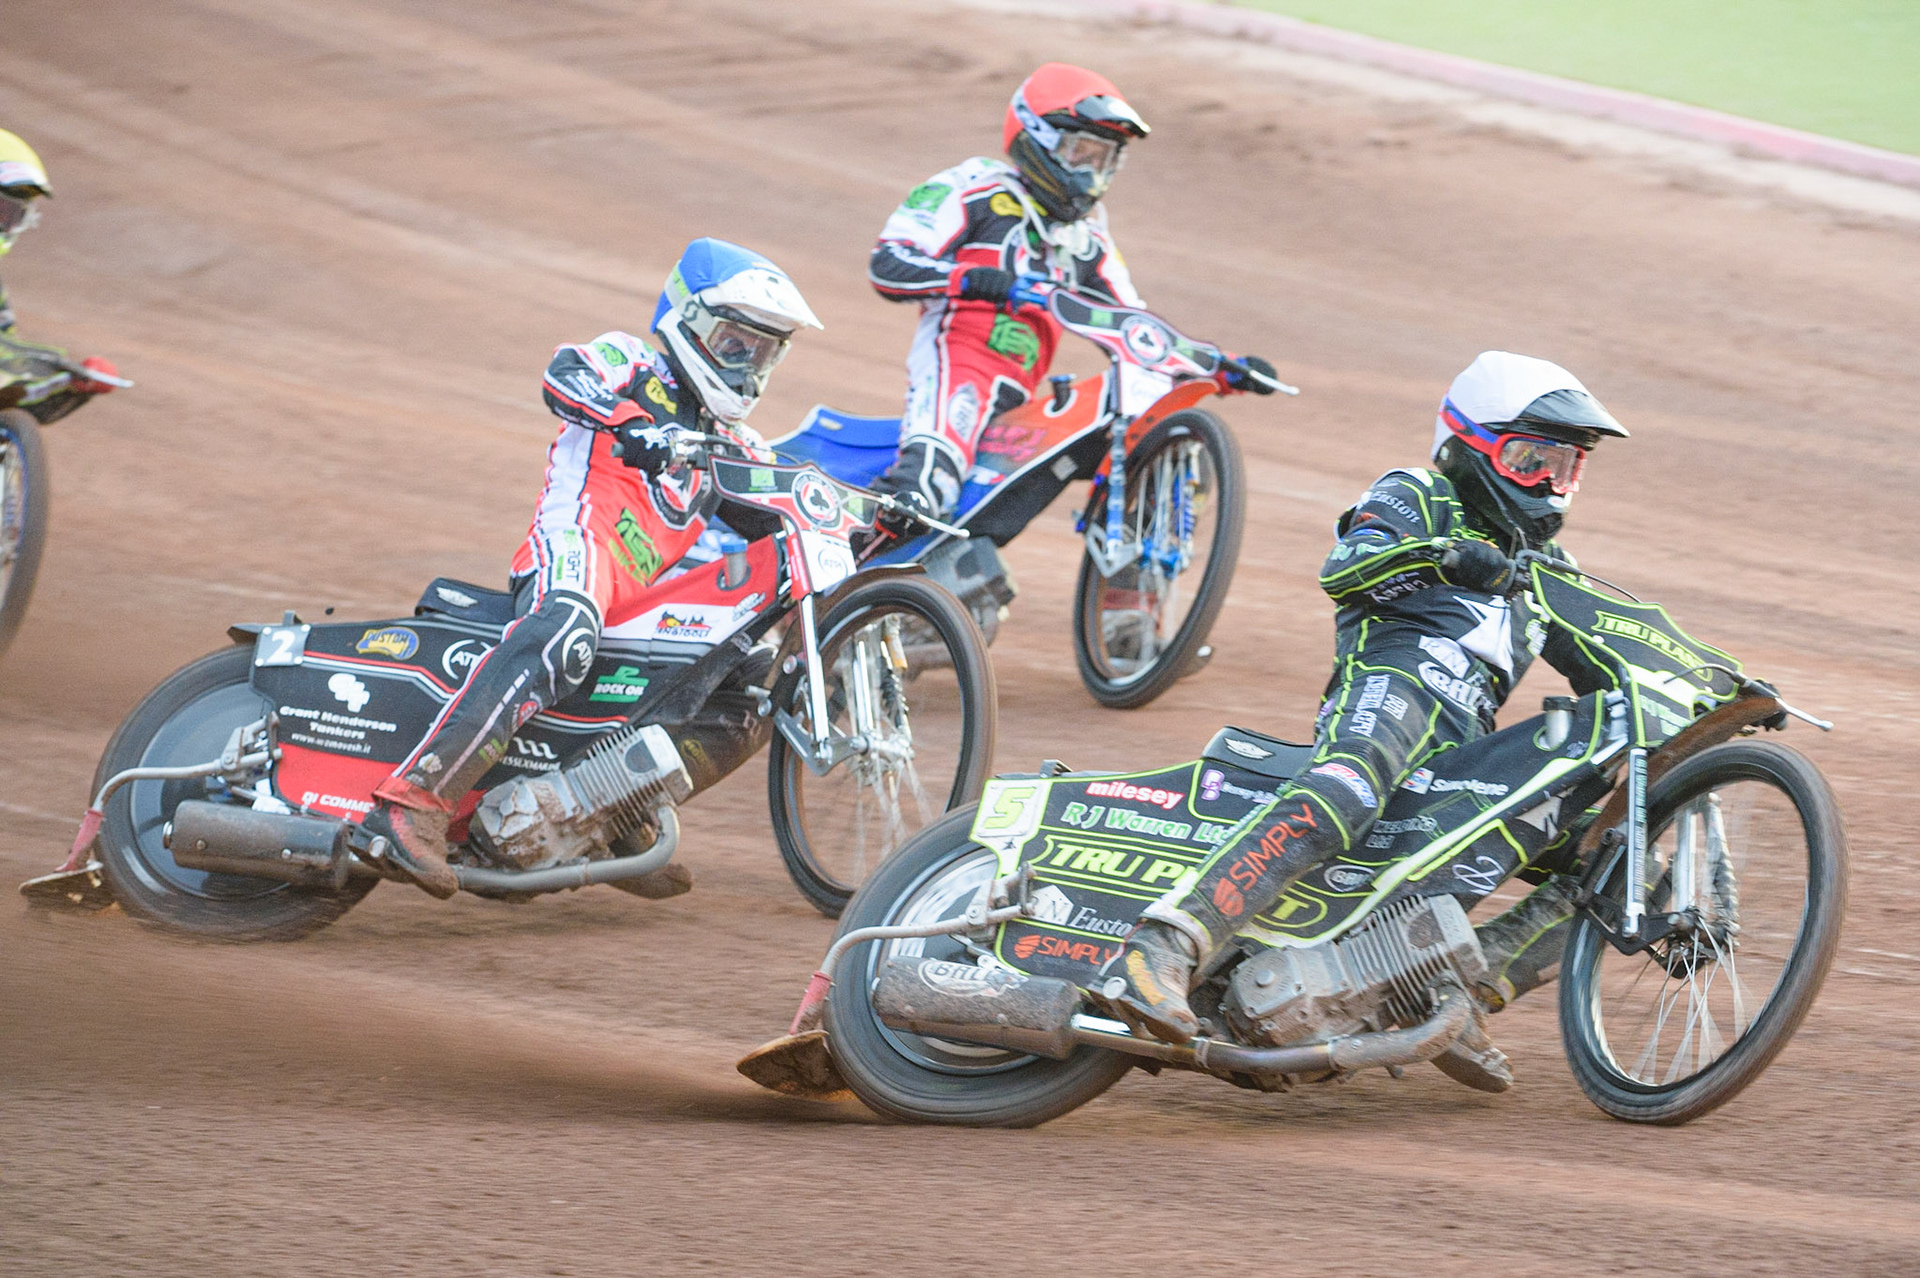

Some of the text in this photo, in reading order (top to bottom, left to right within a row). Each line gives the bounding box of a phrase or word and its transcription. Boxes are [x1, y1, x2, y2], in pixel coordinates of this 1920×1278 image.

[1603, 617, 1650, 640] TRU
[269, 630, 295, 662] 2
[593, 683, 626, 695] ROCK
[279, 705, 398, 733] Grant Henderson
[309, 721, 366, 740] Tankers
[983, 786, 1037, 830] 5
[1085, 781, 1185, 810] milesey
[1104, 807, 1193, 840] Warren
[1049, 843, 1147, 879] TRU
[1229, 803, 1318, 891] SIMPLY
